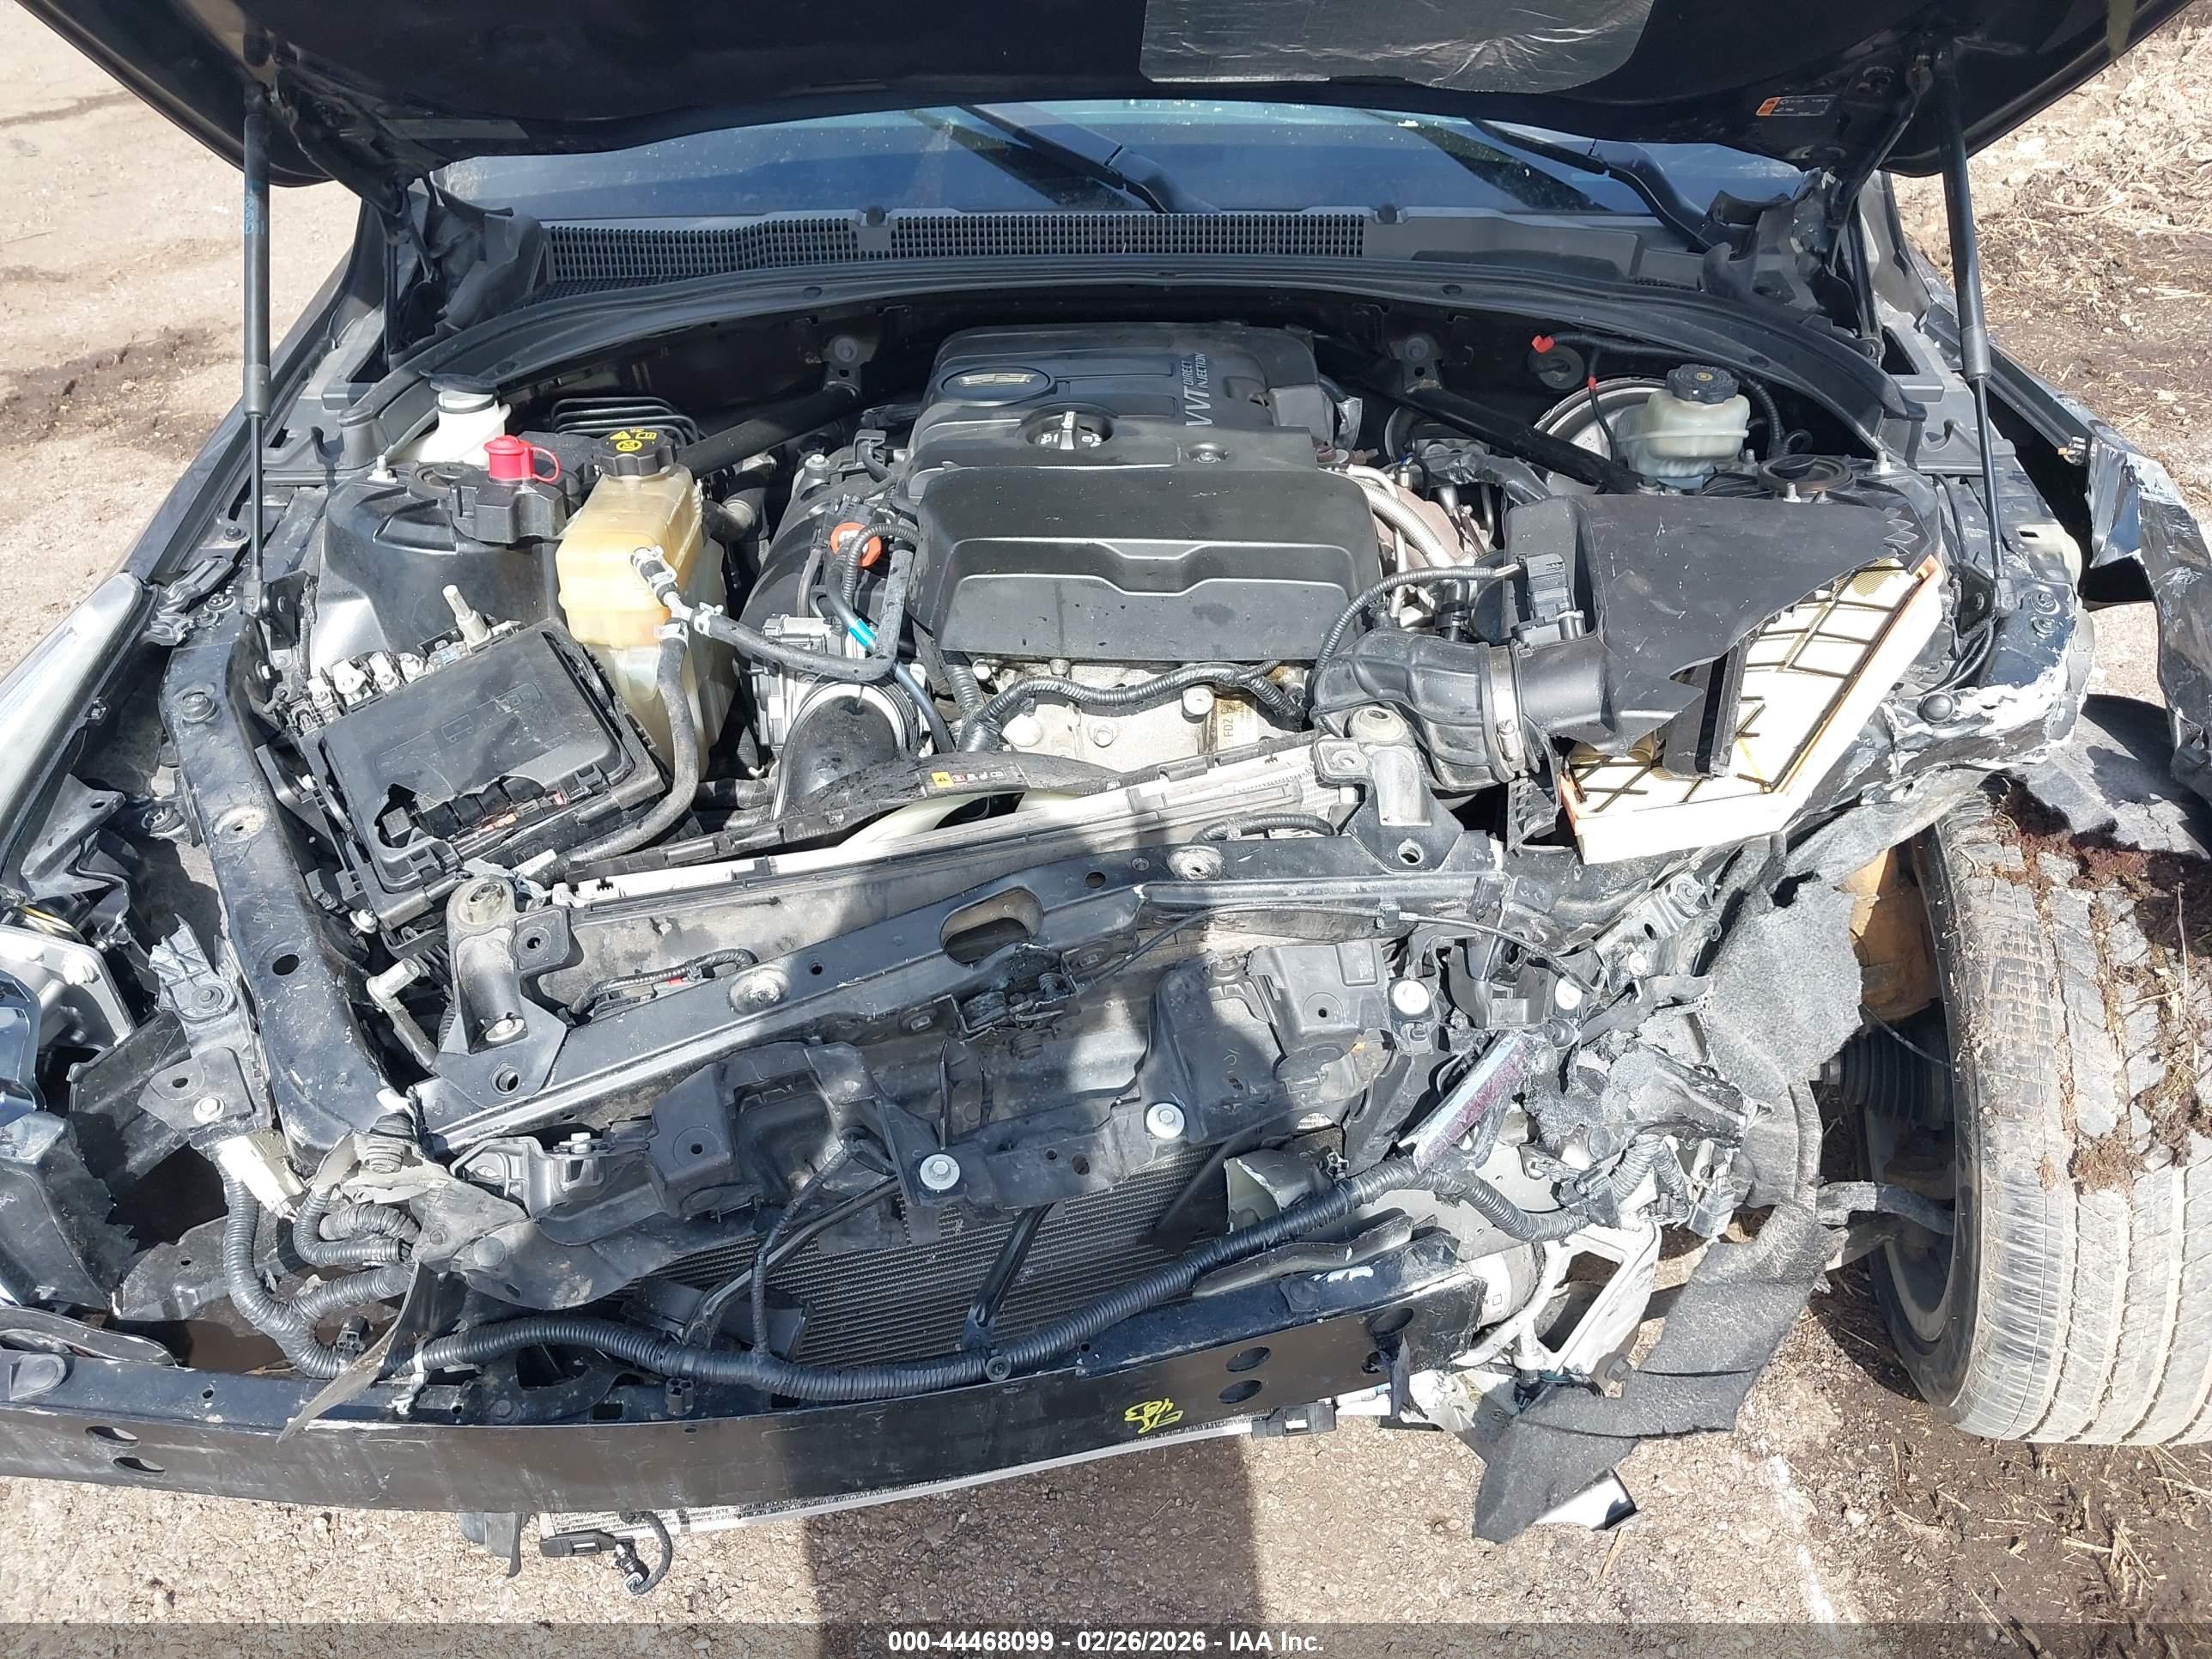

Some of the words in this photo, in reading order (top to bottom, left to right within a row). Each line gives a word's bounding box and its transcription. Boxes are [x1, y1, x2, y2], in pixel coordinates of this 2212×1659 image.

[1181, 359, 1194, 386] DIRECT
[1194, 352, 1210, 389] INJECTION
[1183, 385, 1212, 426] VVT
